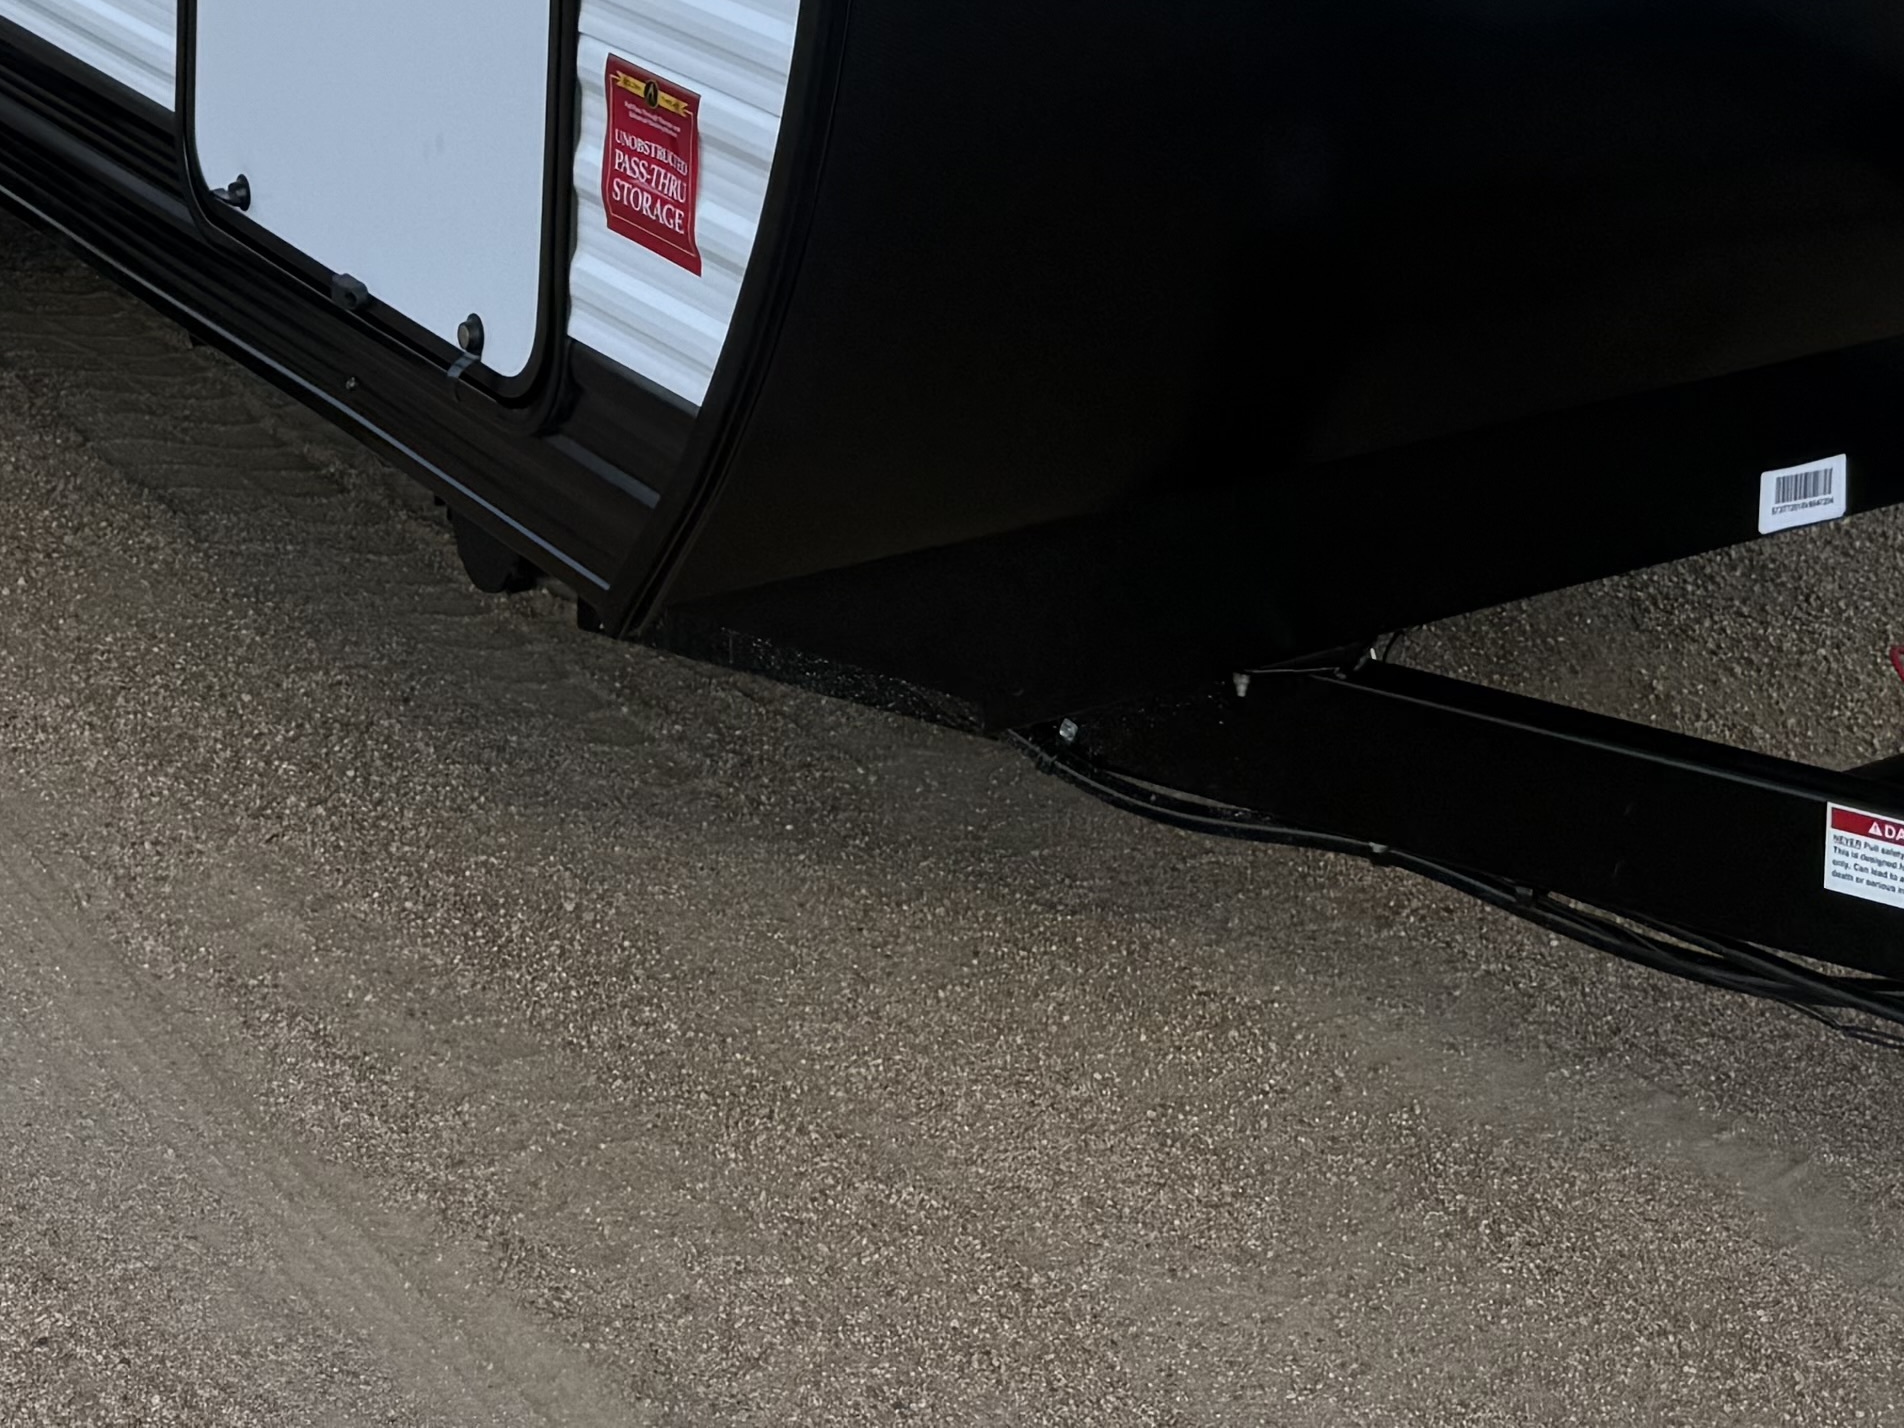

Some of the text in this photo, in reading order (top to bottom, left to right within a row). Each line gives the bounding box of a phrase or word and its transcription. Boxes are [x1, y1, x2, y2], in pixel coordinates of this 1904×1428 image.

[614, 148, 687, 204] PASS-THRU
[615, 127, 688, 177] UNOBSTRUCTED
[612, 177, 685, 235] STORAGE
